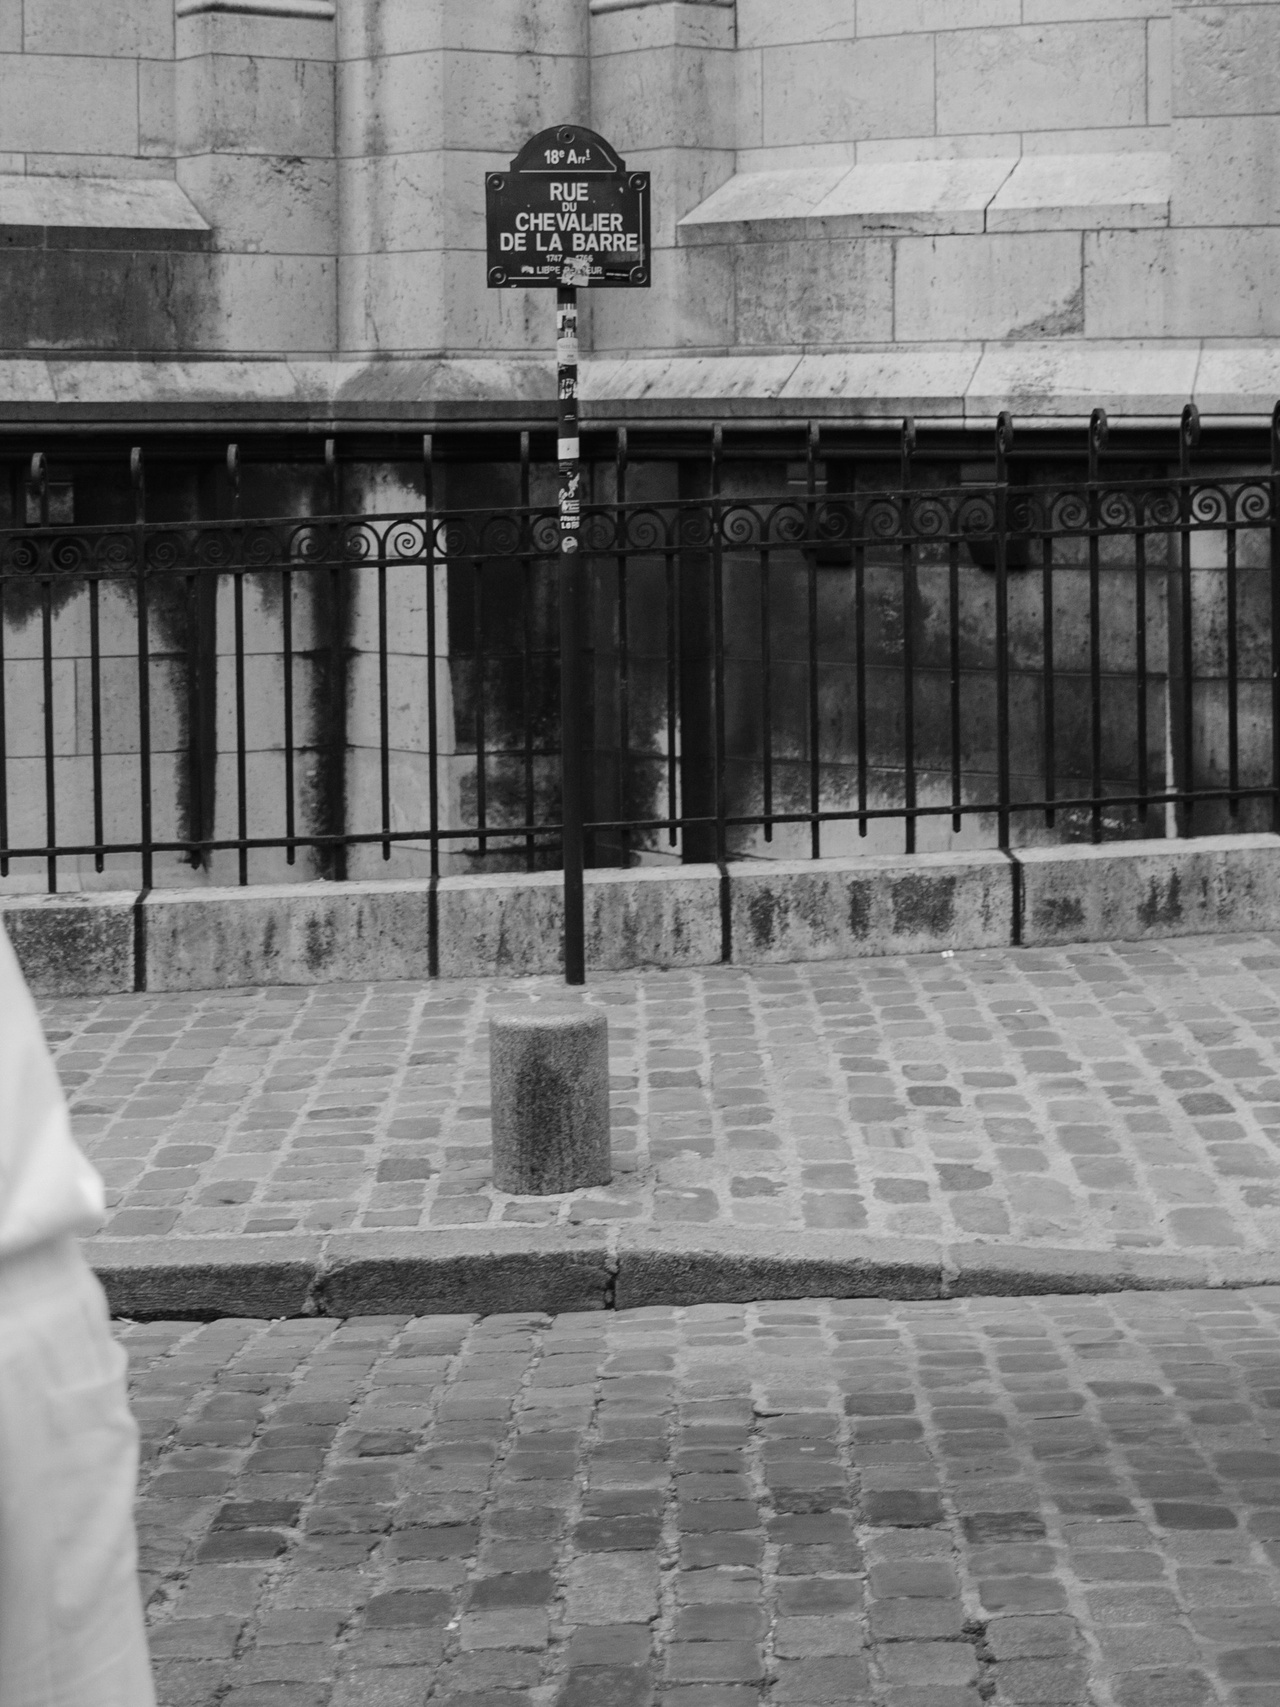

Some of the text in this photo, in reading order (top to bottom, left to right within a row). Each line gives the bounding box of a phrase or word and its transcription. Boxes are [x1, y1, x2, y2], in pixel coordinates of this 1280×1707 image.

[550, 182, 589, 201] RUE
[562, 202, 577, 212] DU
[515, 212, 623, 232] CHEVALIER
[500, 233, 638, 252] DE LA BARRE
